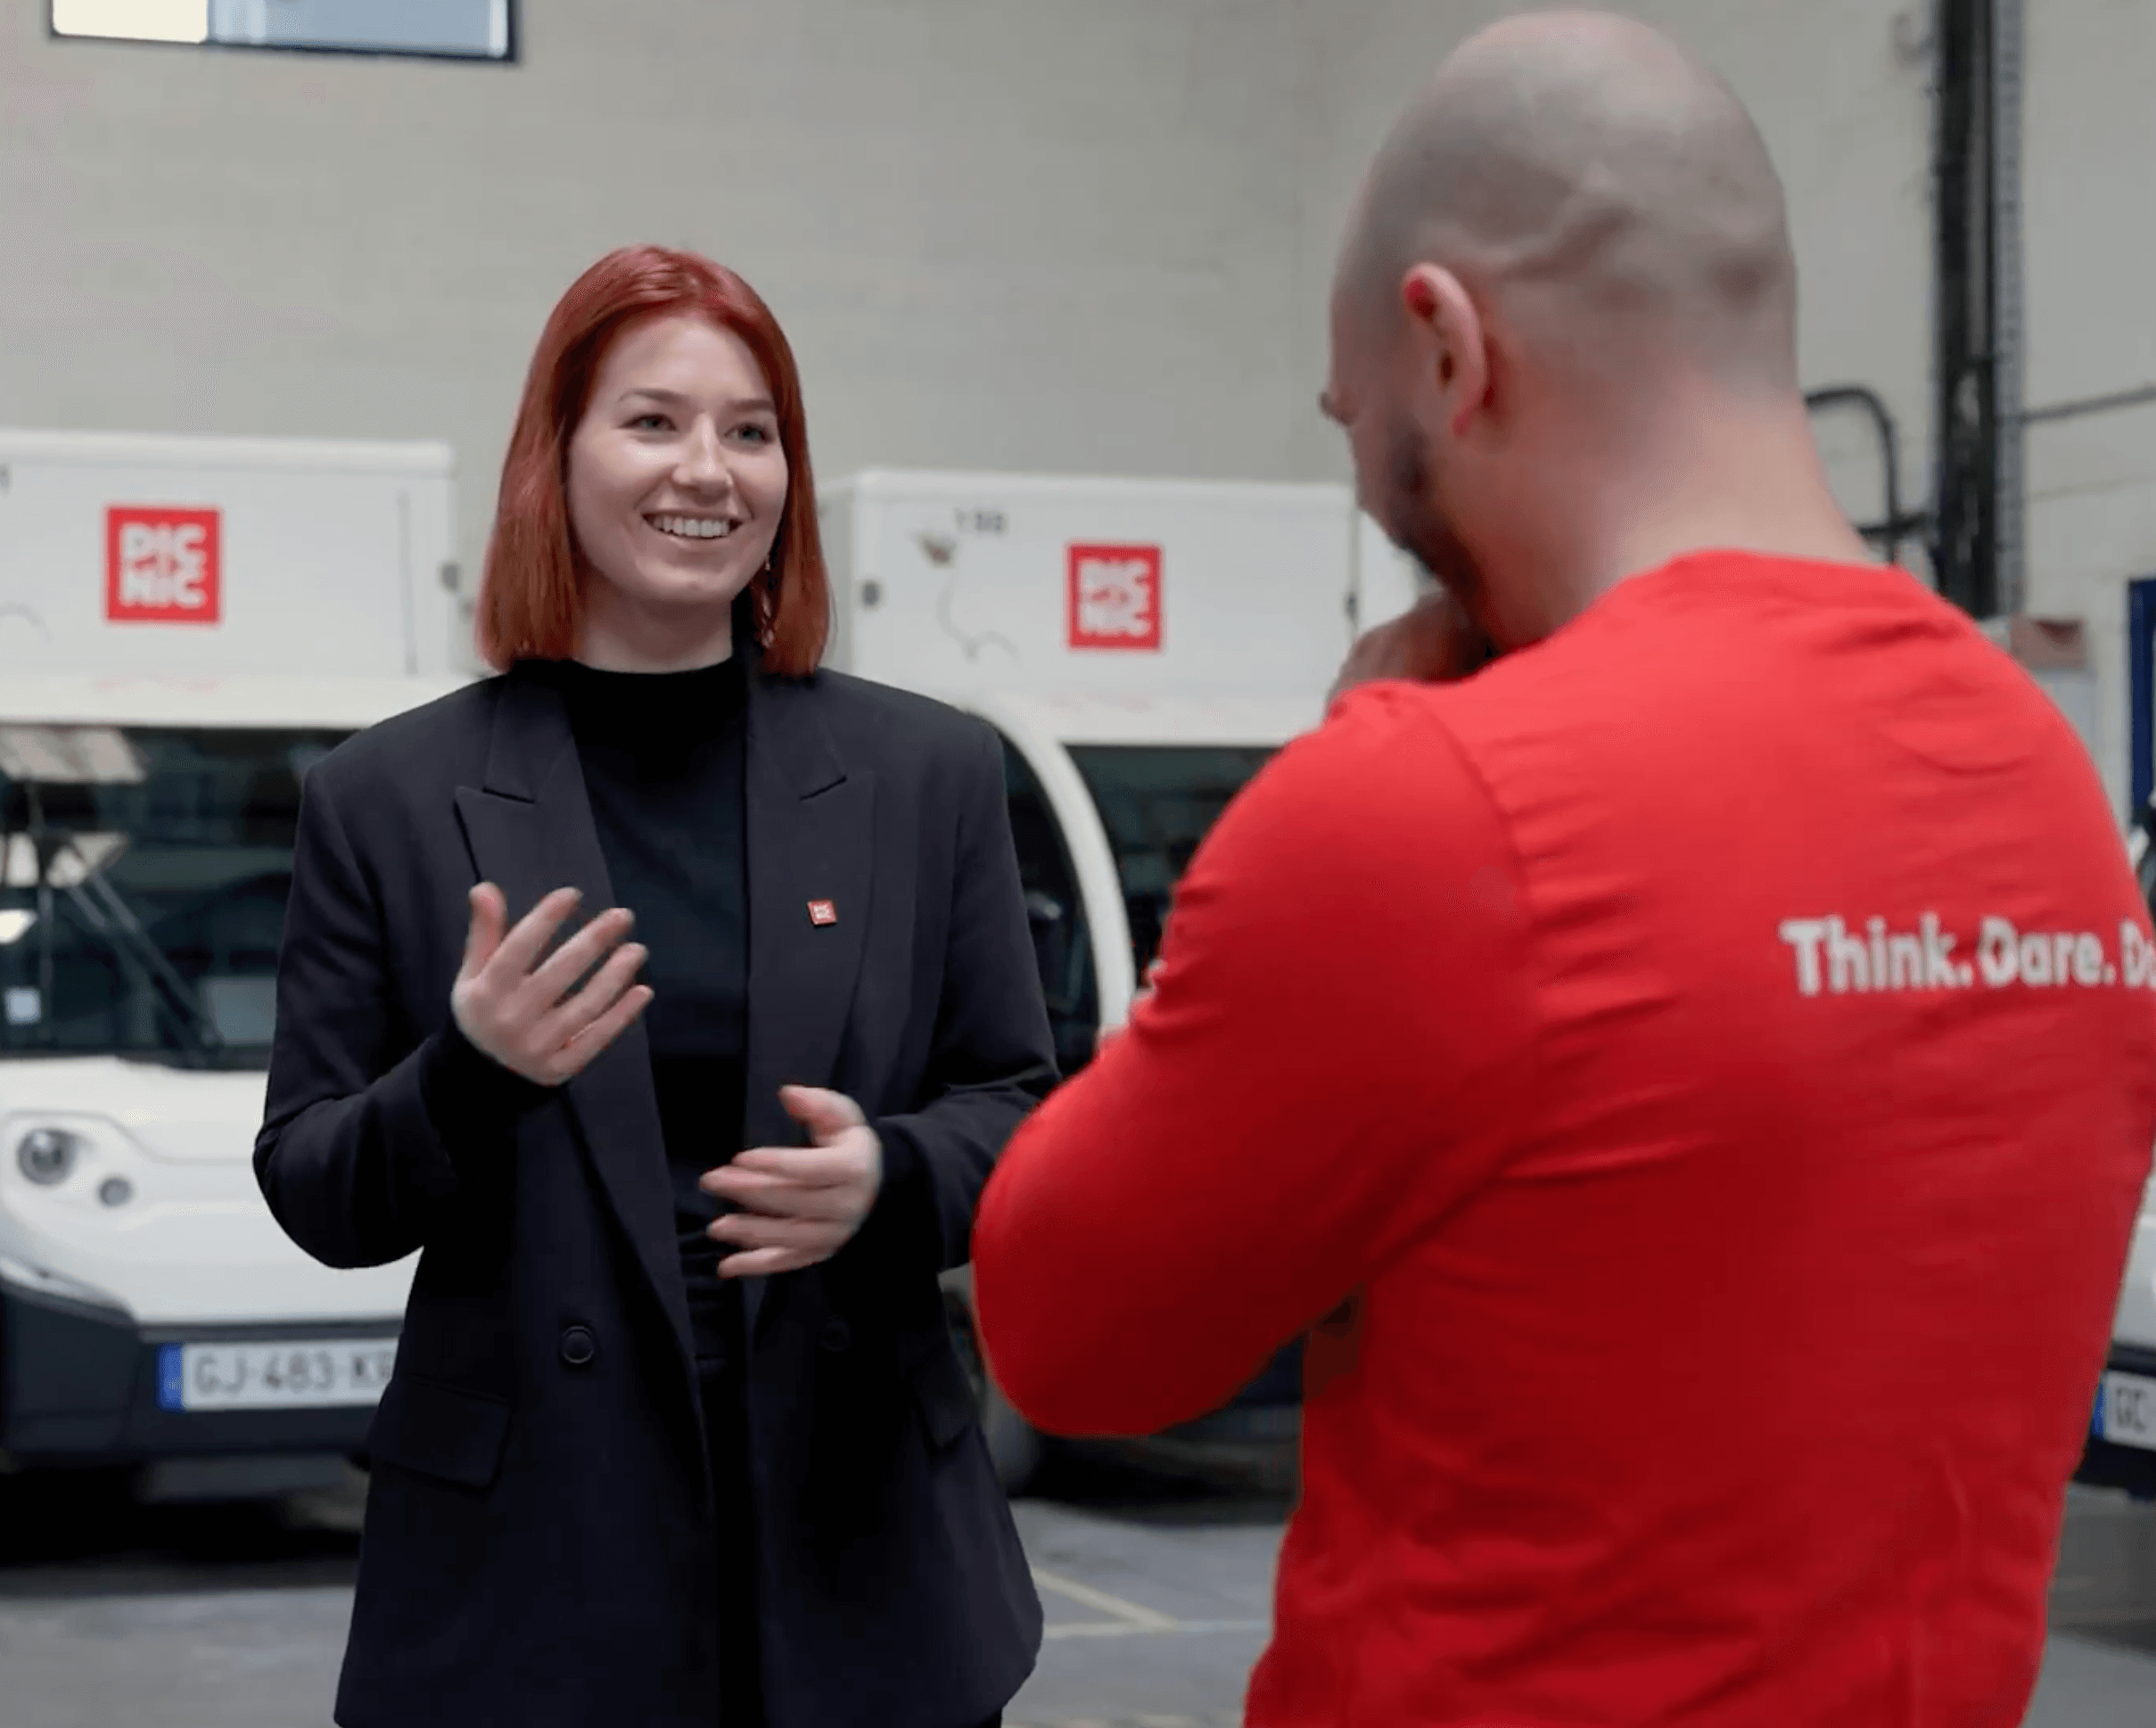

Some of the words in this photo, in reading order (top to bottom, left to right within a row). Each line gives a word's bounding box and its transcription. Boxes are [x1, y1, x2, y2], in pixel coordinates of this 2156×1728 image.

[119, 523, 207, 565] PIC
[1780, 911, 1973, 996] Think.
[1979, 916, 2115, 988] Dare.
